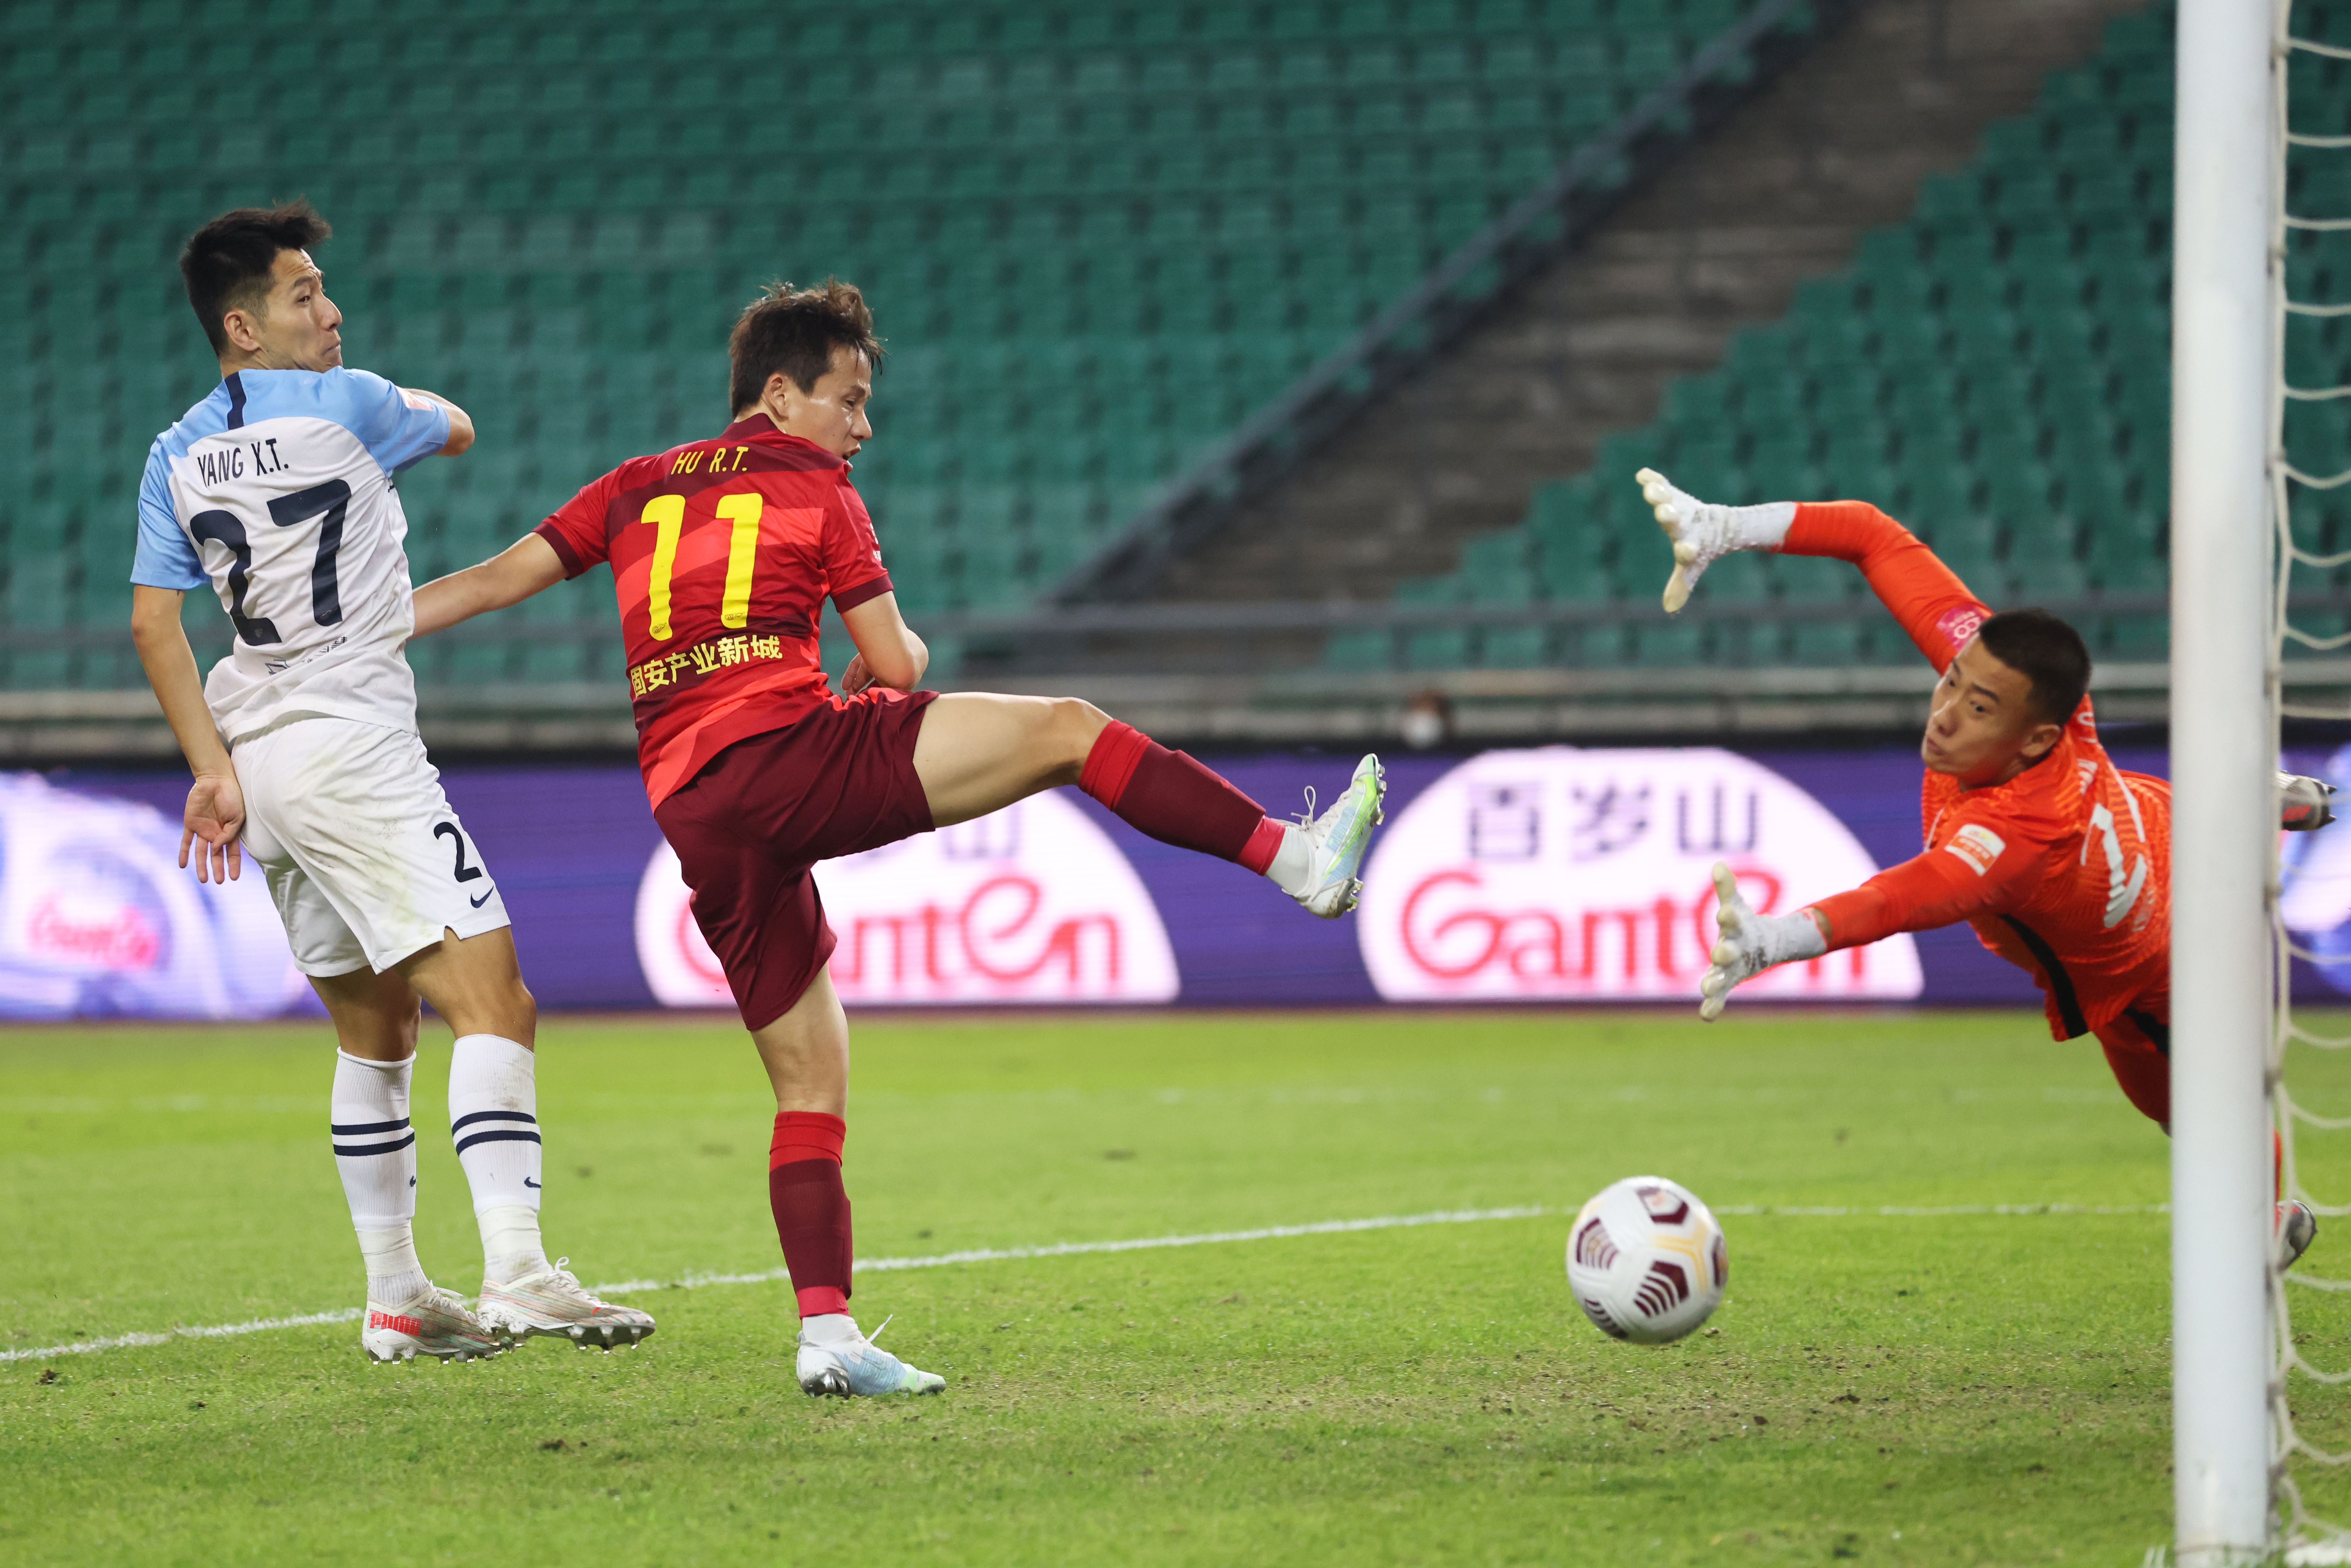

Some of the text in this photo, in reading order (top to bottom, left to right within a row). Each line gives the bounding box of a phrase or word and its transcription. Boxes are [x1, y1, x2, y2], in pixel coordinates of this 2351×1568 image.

[197, 438, 289, 487] YANG X.T.
[671, 446, 749, 475] HU R.T.
[190, 479, 351, 646] 27
[641, 492, 763, 641] 11
[630, 635, 783, 698] 固安产业新城
[1468, 779, 1758, 862] 百岁山
